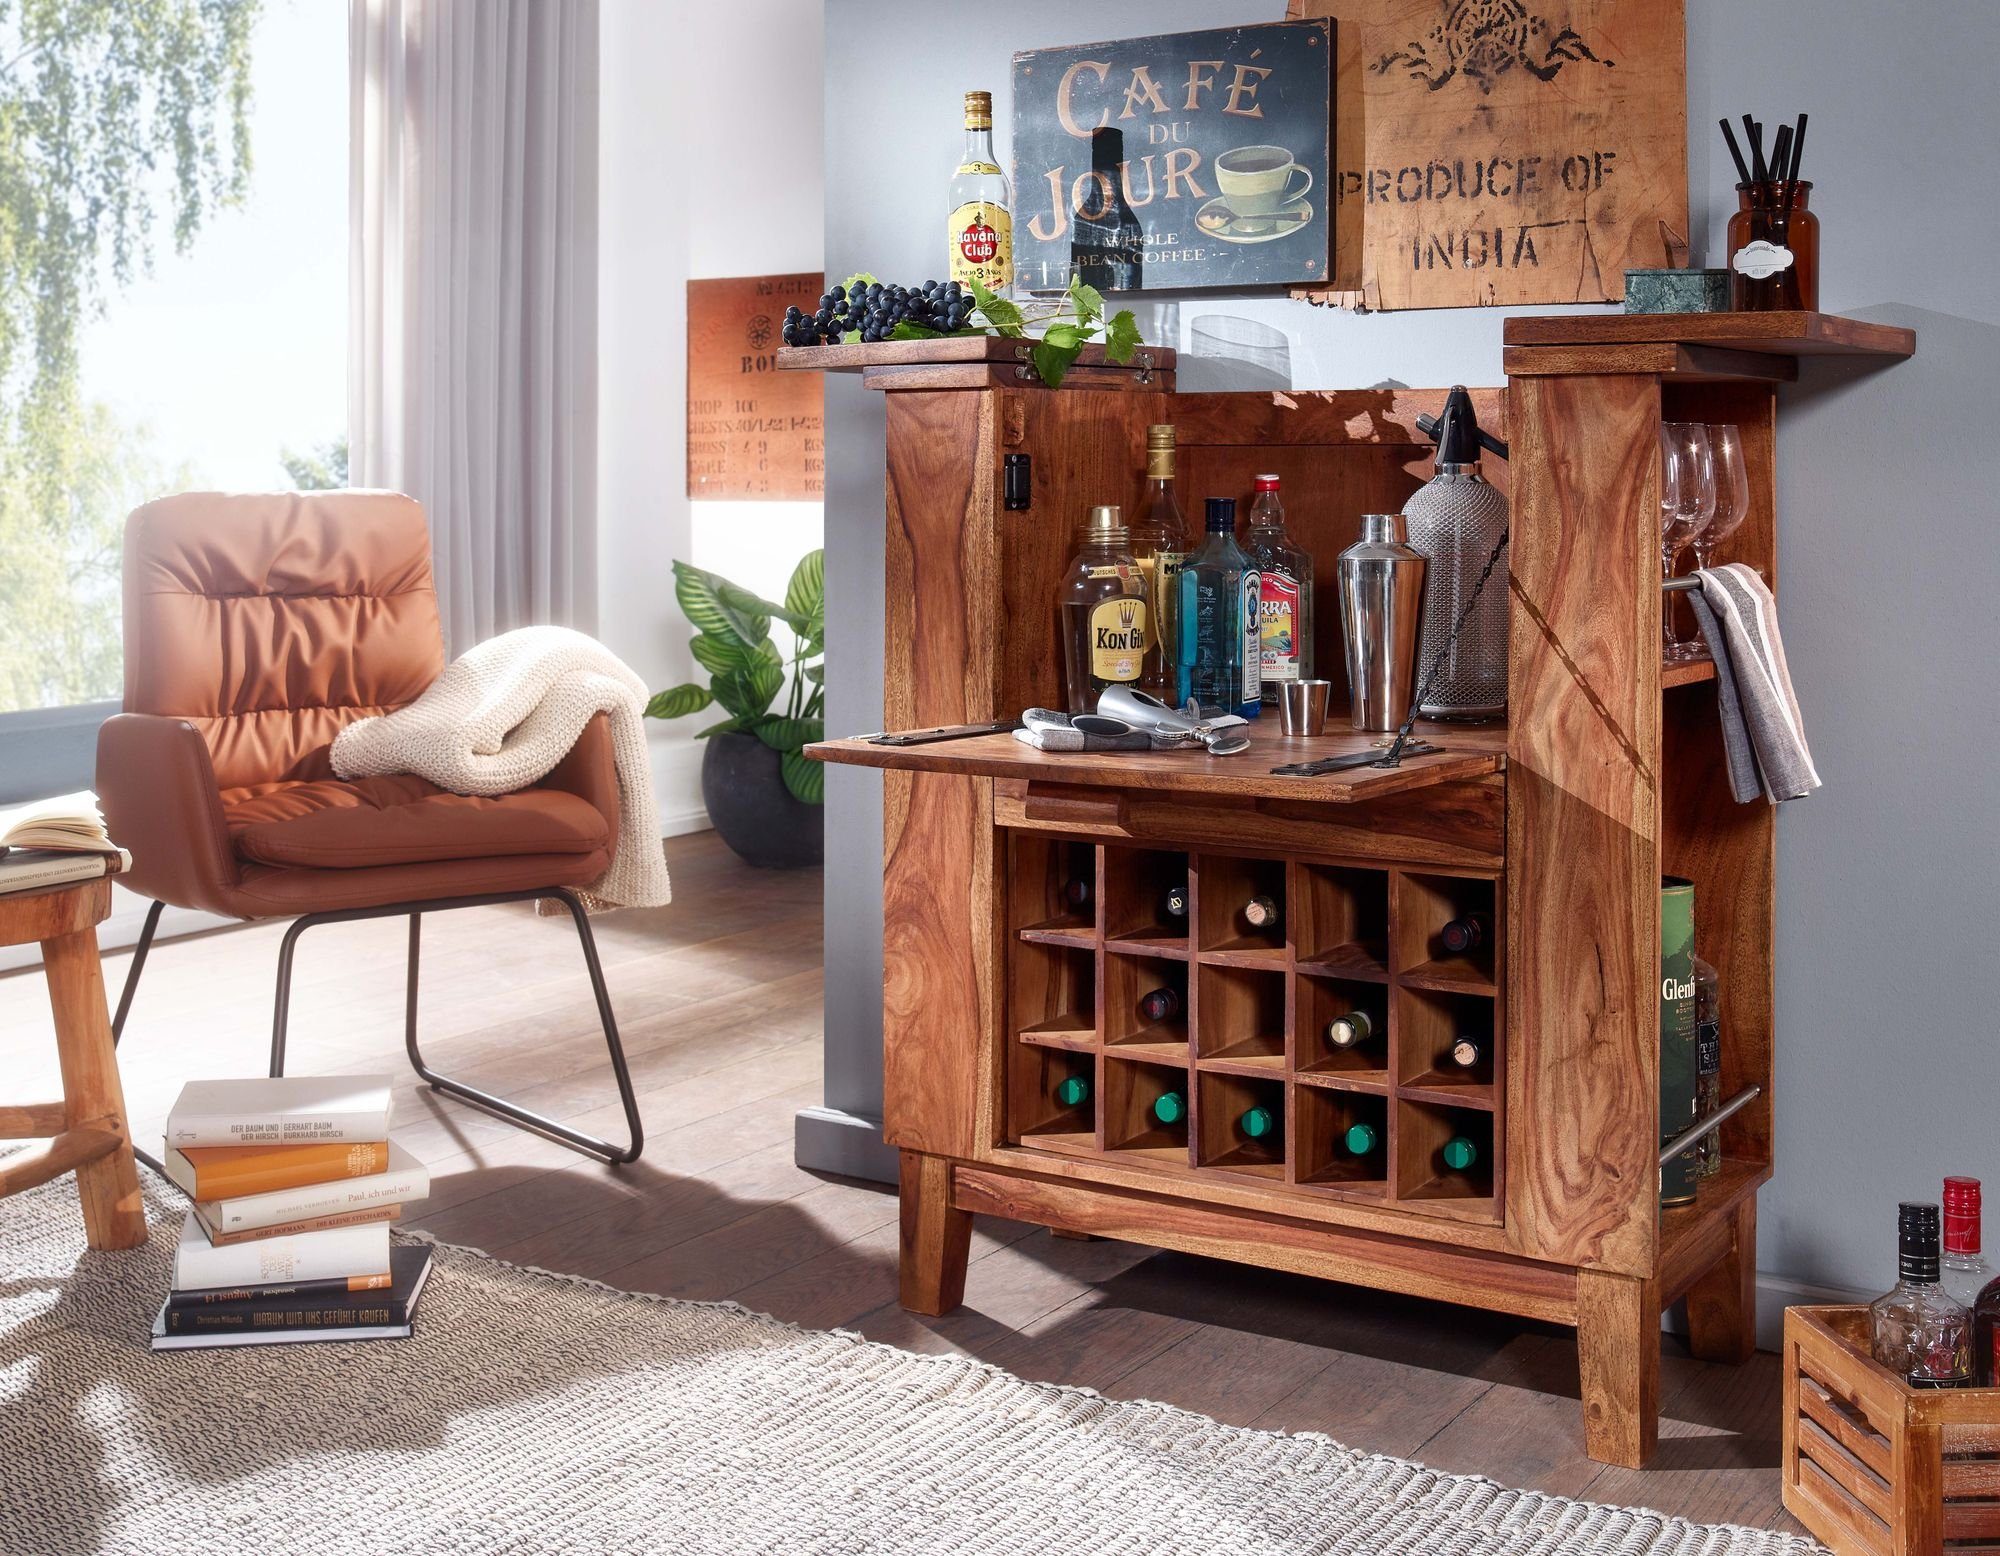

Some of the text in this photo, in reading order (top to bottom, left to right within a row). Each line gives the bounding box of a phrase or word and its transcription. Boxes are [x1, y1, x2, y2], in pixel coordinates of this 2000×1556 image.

[1057, 48, 1273, 138] CAFÉ
[1149, 121, 1191, 145] DU
[1338, 152, 1617, 206] PRODUCE OF
[1026, 148, 1207, 241] JOUR
[957, 230, 1002, 243] Havana
[1105, 232, 1179, 248] WHOLE
[965, 244, 993, 256] Club
[1413, 224, 1538, 271] INDIA
[1077, 249, 1206, 267] BEAN COFFEE
[231, 1121, 332, 1133] DER BAUM UND GERHART BAUM
[241, 1129, 343, 1141] DER HIRSCH BURKHARD HIRSCH
[348, 1192, 366, 1203] Paul,
[368, 1189, 380, 1199] ich
[380, 1187, 397, 1197] und
[399, 1184, 411, 1194] wir
[253, 1311, 284, 1326] WARUM
[285, 1310, 303, 1325] WIR
[305, 1310, 321, 1324] UNS
[323, 1308, 356, 1324] GEFÜHLE
[359, 1308, 390, 1323] KAUFEN
